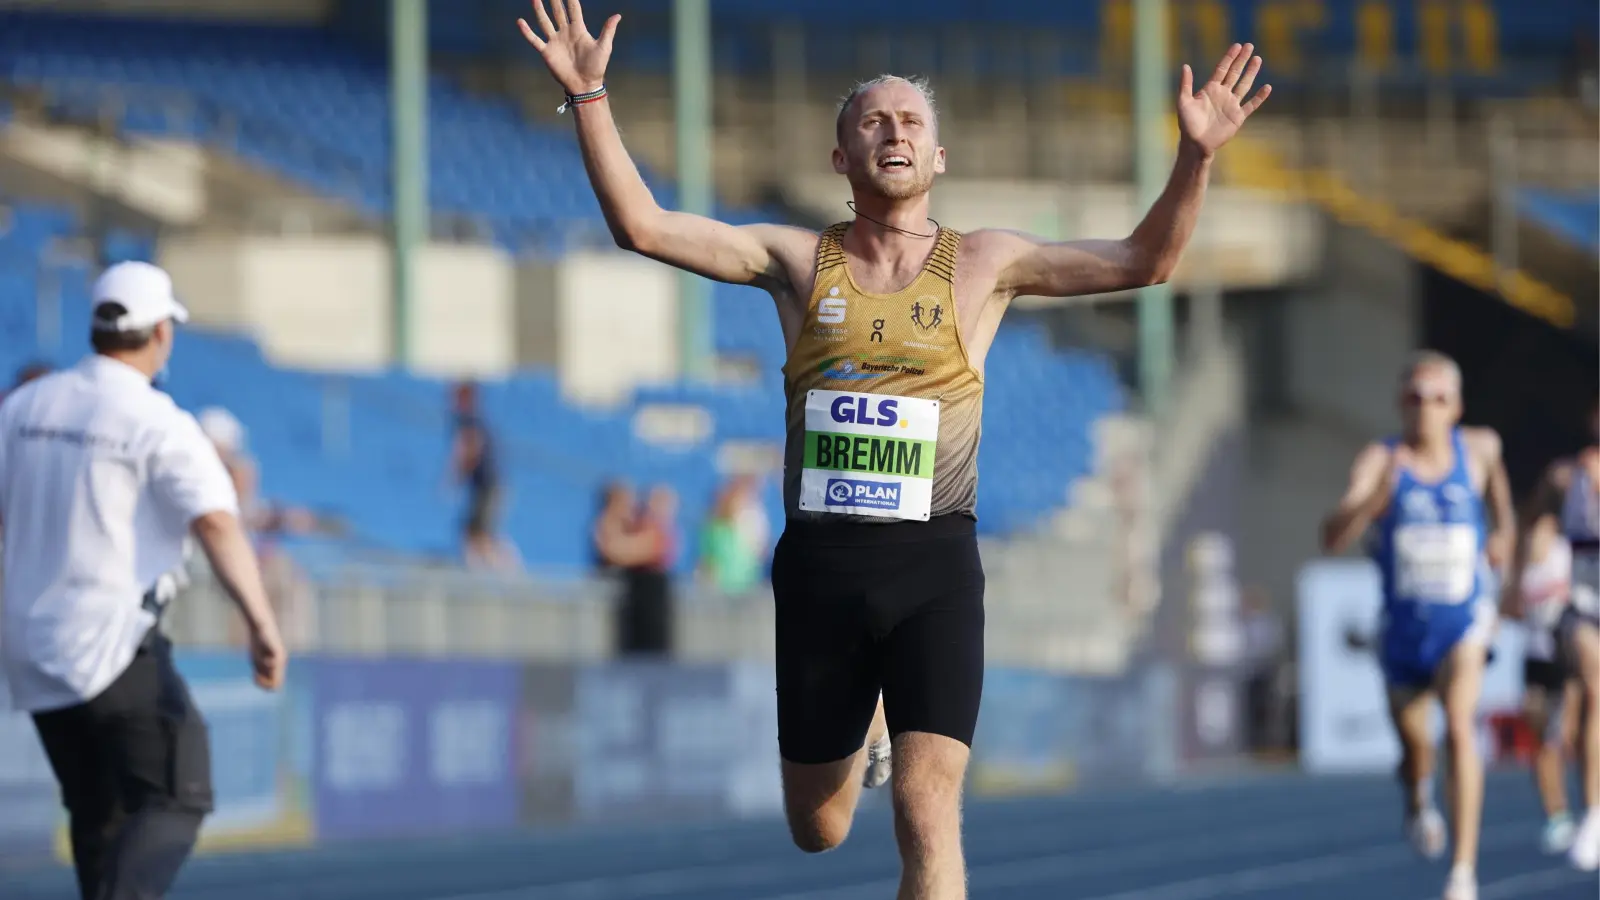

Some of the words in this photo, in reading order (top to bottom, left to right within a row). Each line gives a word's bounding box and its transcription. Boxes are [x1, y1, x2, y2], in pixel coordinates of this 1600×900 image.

[861, 362, 900, 373] Bayerische
[900, 366, 925, 376] Polizei
[816, 434, 922, 475] BREMM
[855, 485, 898, 500] PLAN
[854, 498, 897, 507] INTERNATIONAL
